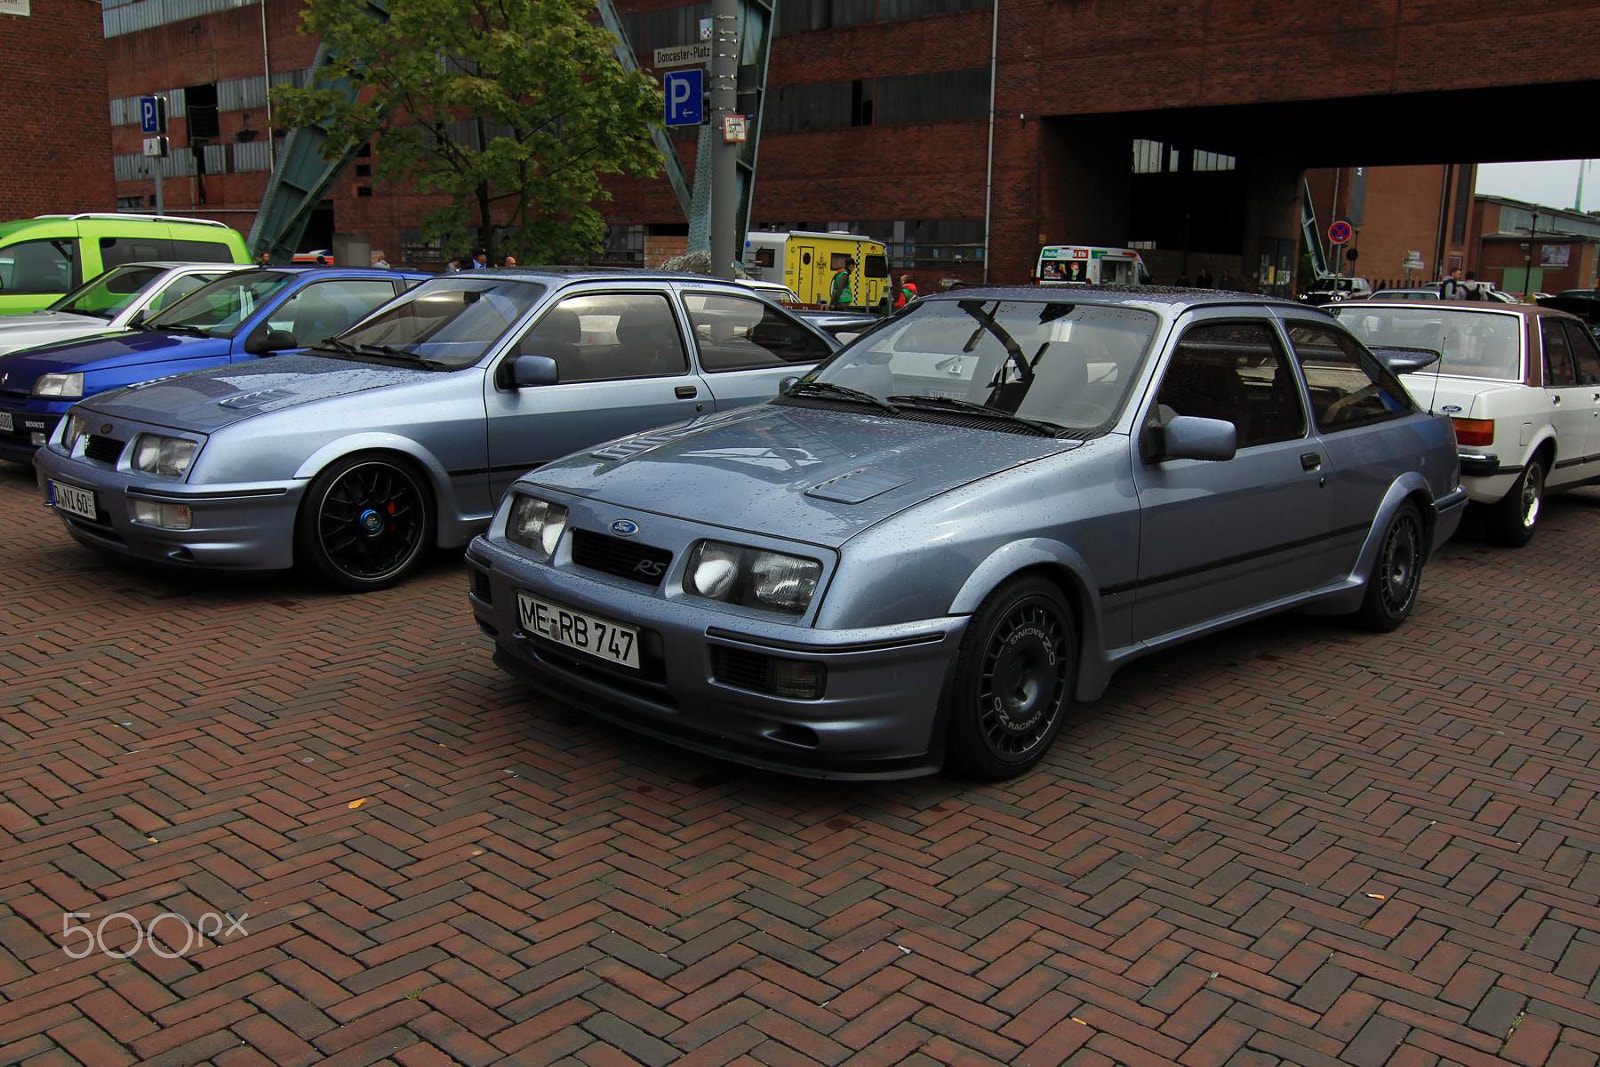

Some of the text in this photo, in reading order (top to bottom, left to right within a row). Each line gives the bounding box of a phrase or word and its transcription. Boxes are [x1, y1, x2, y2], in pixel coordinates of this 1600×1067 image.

[657, 46, 710, 63] Doncaster-Platz
[671, 78, 691, 119] P
[143, 102, 154, 129] P
[633, 559, 668, 577] RS
[594, 622, 634, 661] 747
[1010, 627, 1045, 645] RACING
[1008, 710, 1042, 731] RACING
